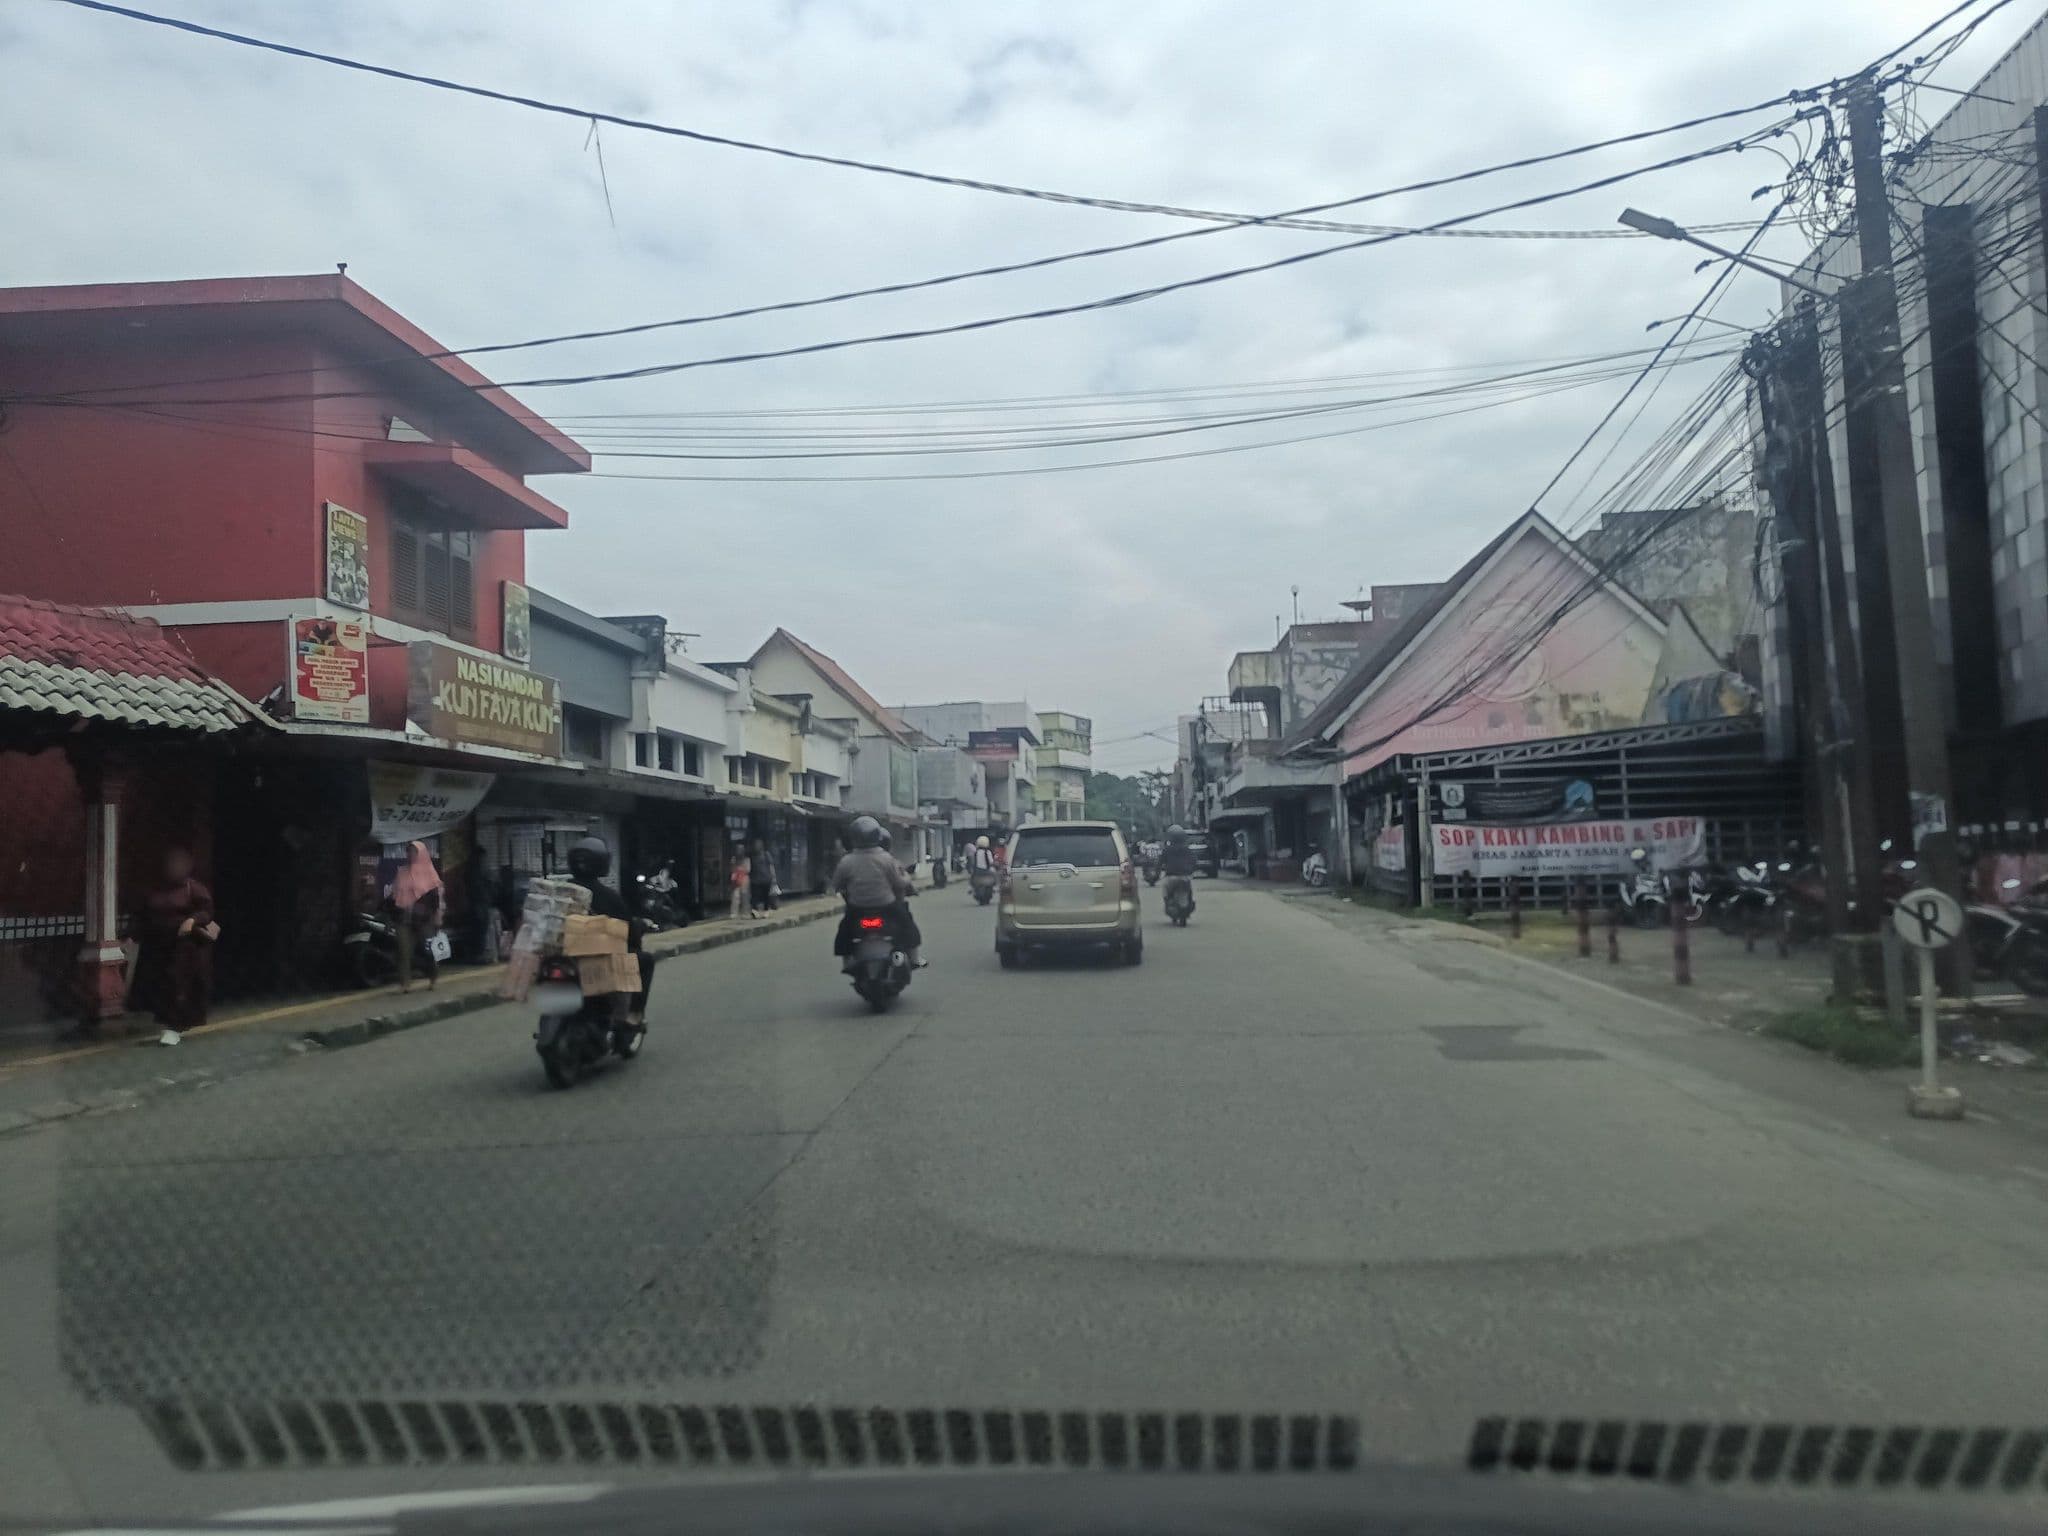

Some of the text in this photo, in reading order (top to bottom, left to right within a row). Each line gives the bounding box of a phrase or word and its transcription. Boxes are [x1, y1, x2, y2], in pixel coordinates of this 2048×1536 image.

[457, 656, 544, 700] NASI KANDAR
[397, 792, 449, 808] SUSAN
[1440, 829, 1475, 846] SOP
[1483, 829, 1528, 846] KAKI
[1536, 825, 1624, 845] KAMBING
[1511, 849, 1570, 859] JAKARTA
[1576, 846, 1619, 857] TANAH
